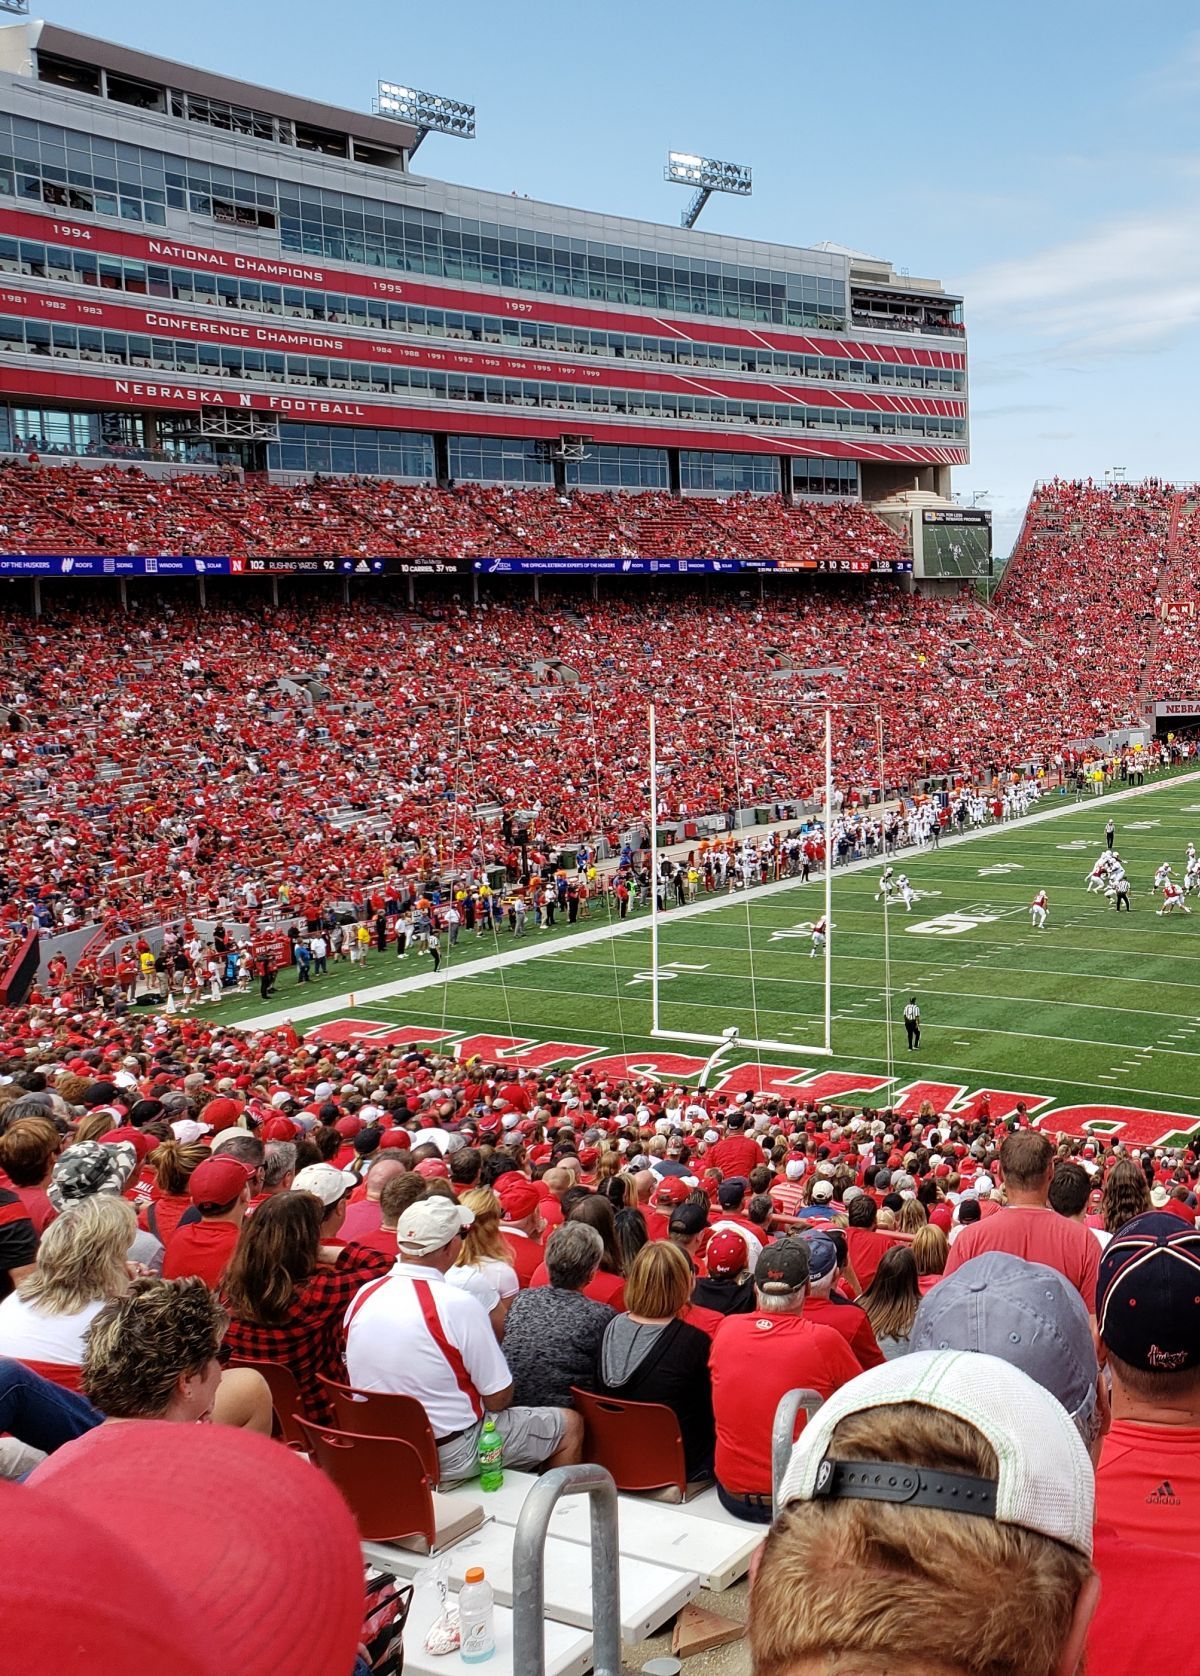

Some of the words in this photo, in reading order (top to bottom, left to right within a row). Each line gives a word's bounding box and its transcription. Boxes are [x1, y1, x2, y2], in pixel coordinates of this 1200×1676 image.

[53, 224, 92, 240] 1994
[148, 240, 228, 267] NATIONAL
[234, 256, 324, 283] CHAMPIONS
[372, 281, 402, 294] 1995
[1, 293, 28, 305] 1981
[40, 299, 66, 311] 1982
[77, 305, 103, 316] 1983
[505, 301, 533, 313] 1997
[145, 312, 250, 340] CONFERENCE
[256, 329, 344, 351] CHAMPIONS
[371, 345, 392, 355] 1984
[427, 352, 446, 361] 1991
[454, 356, 473, 364] 1992
[481, 358, 500, 367] 1993
[507, 362, 526, 370] 1994
[533, 364, 552, 373] 1995
[558, 367, 576, 375] 1997
[582, 369, 600, 377] 1999
[115, 380, 224, 405] NEBRASKA
[239, 393, 252, 407] N
[270, 396, 365, 417] FOOTBALL
[232, 560, 242, 571] N
[250, 561, 265, 569] 102
[269, 561, 297, 569] RUSHING
[298, 562, 317, 570] YARDS
[323, 561, 335, 570] 92
[436, 565, 444, 573] 37
[820, 561, 825, 569] 2
[841, 561, 849, 569] 32
[1144, 705, 1153, 714] N
[1145, 1496, 1181, 1506] adidas
